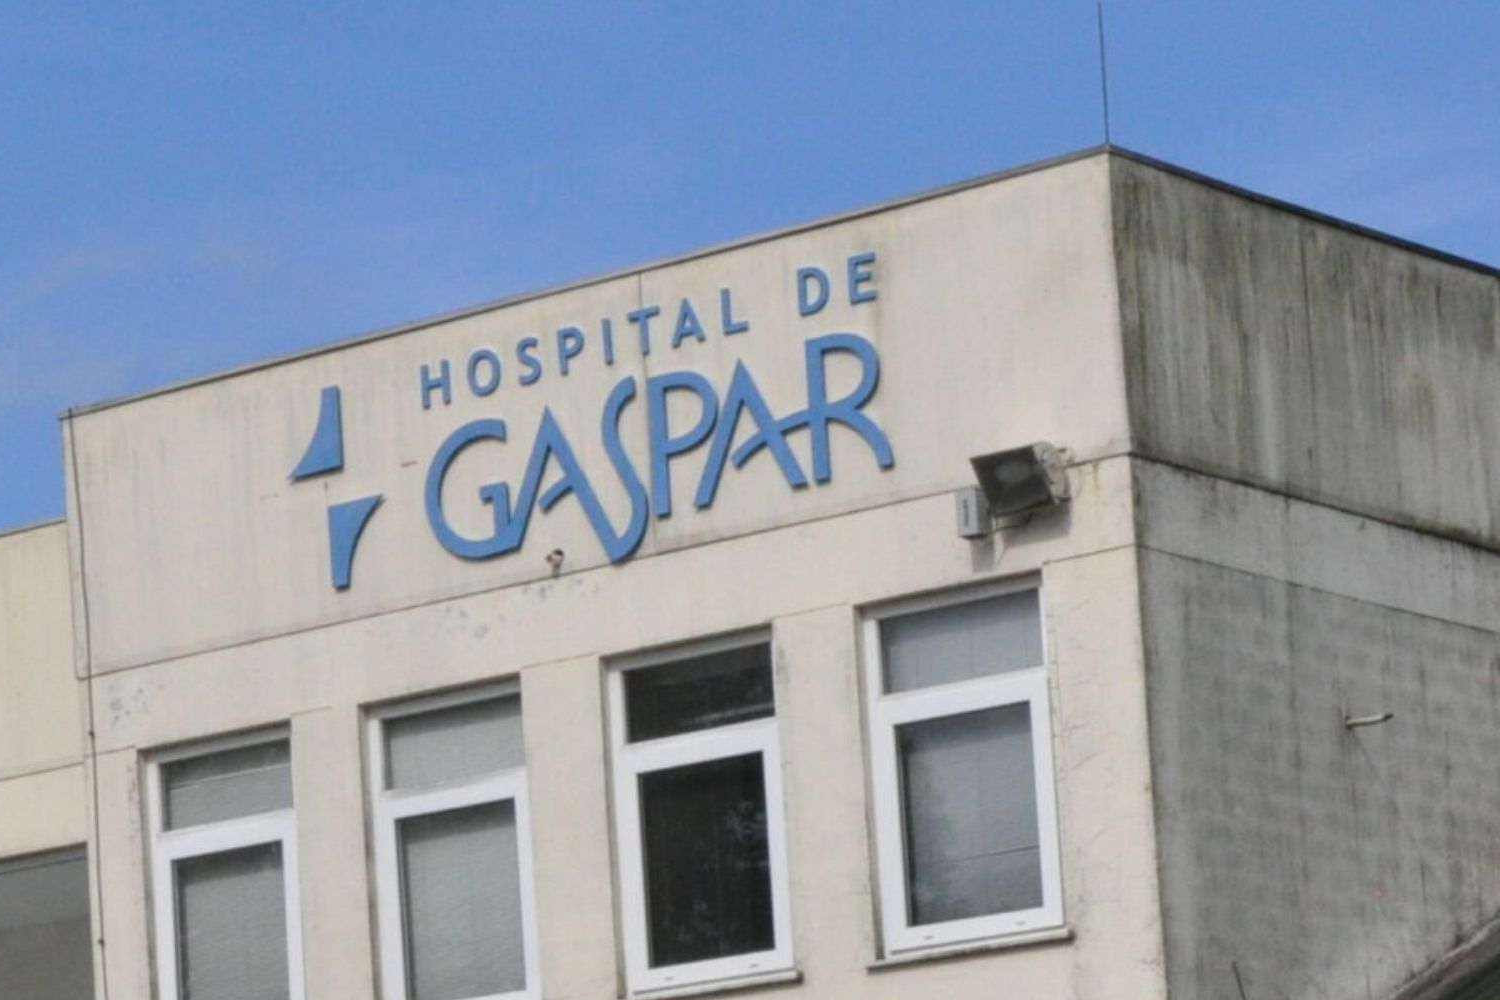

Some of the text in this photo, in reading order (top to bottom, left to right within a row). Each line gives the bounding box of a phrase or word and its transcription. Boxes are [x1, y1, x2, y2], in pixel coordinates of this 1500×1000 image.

[419, 251, 878, 410] HOSPITAL DE
[424, 332, 895, 563] GASPAR
